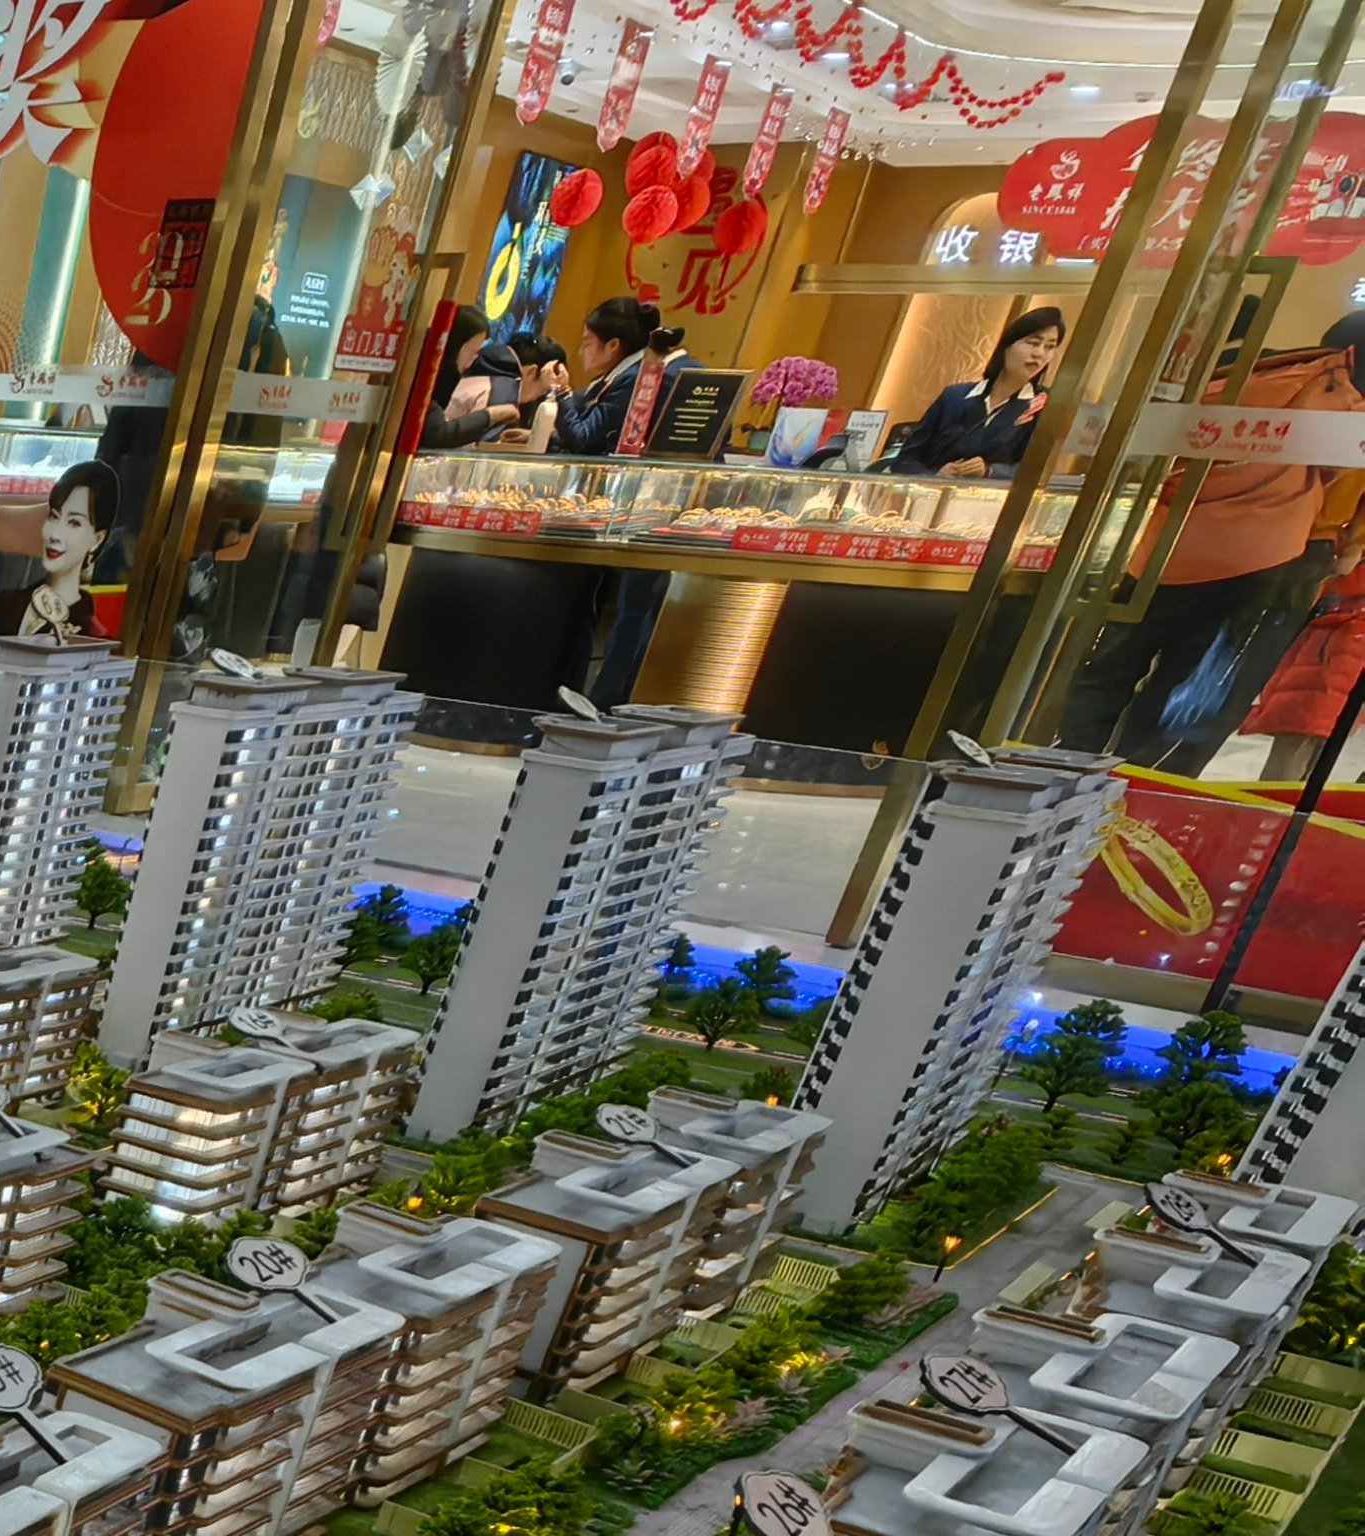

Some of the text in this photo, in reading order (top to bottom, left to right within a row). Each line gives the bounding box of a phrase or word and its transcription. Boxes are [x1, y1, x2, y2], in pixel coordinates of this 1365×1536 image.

[936, 224, 1096, 265] 收银
[605, 1111, 649, 1136] 21#
[239, 1243, 299, 1282] 20#
[938, 1359, 997, 1404] 27#
